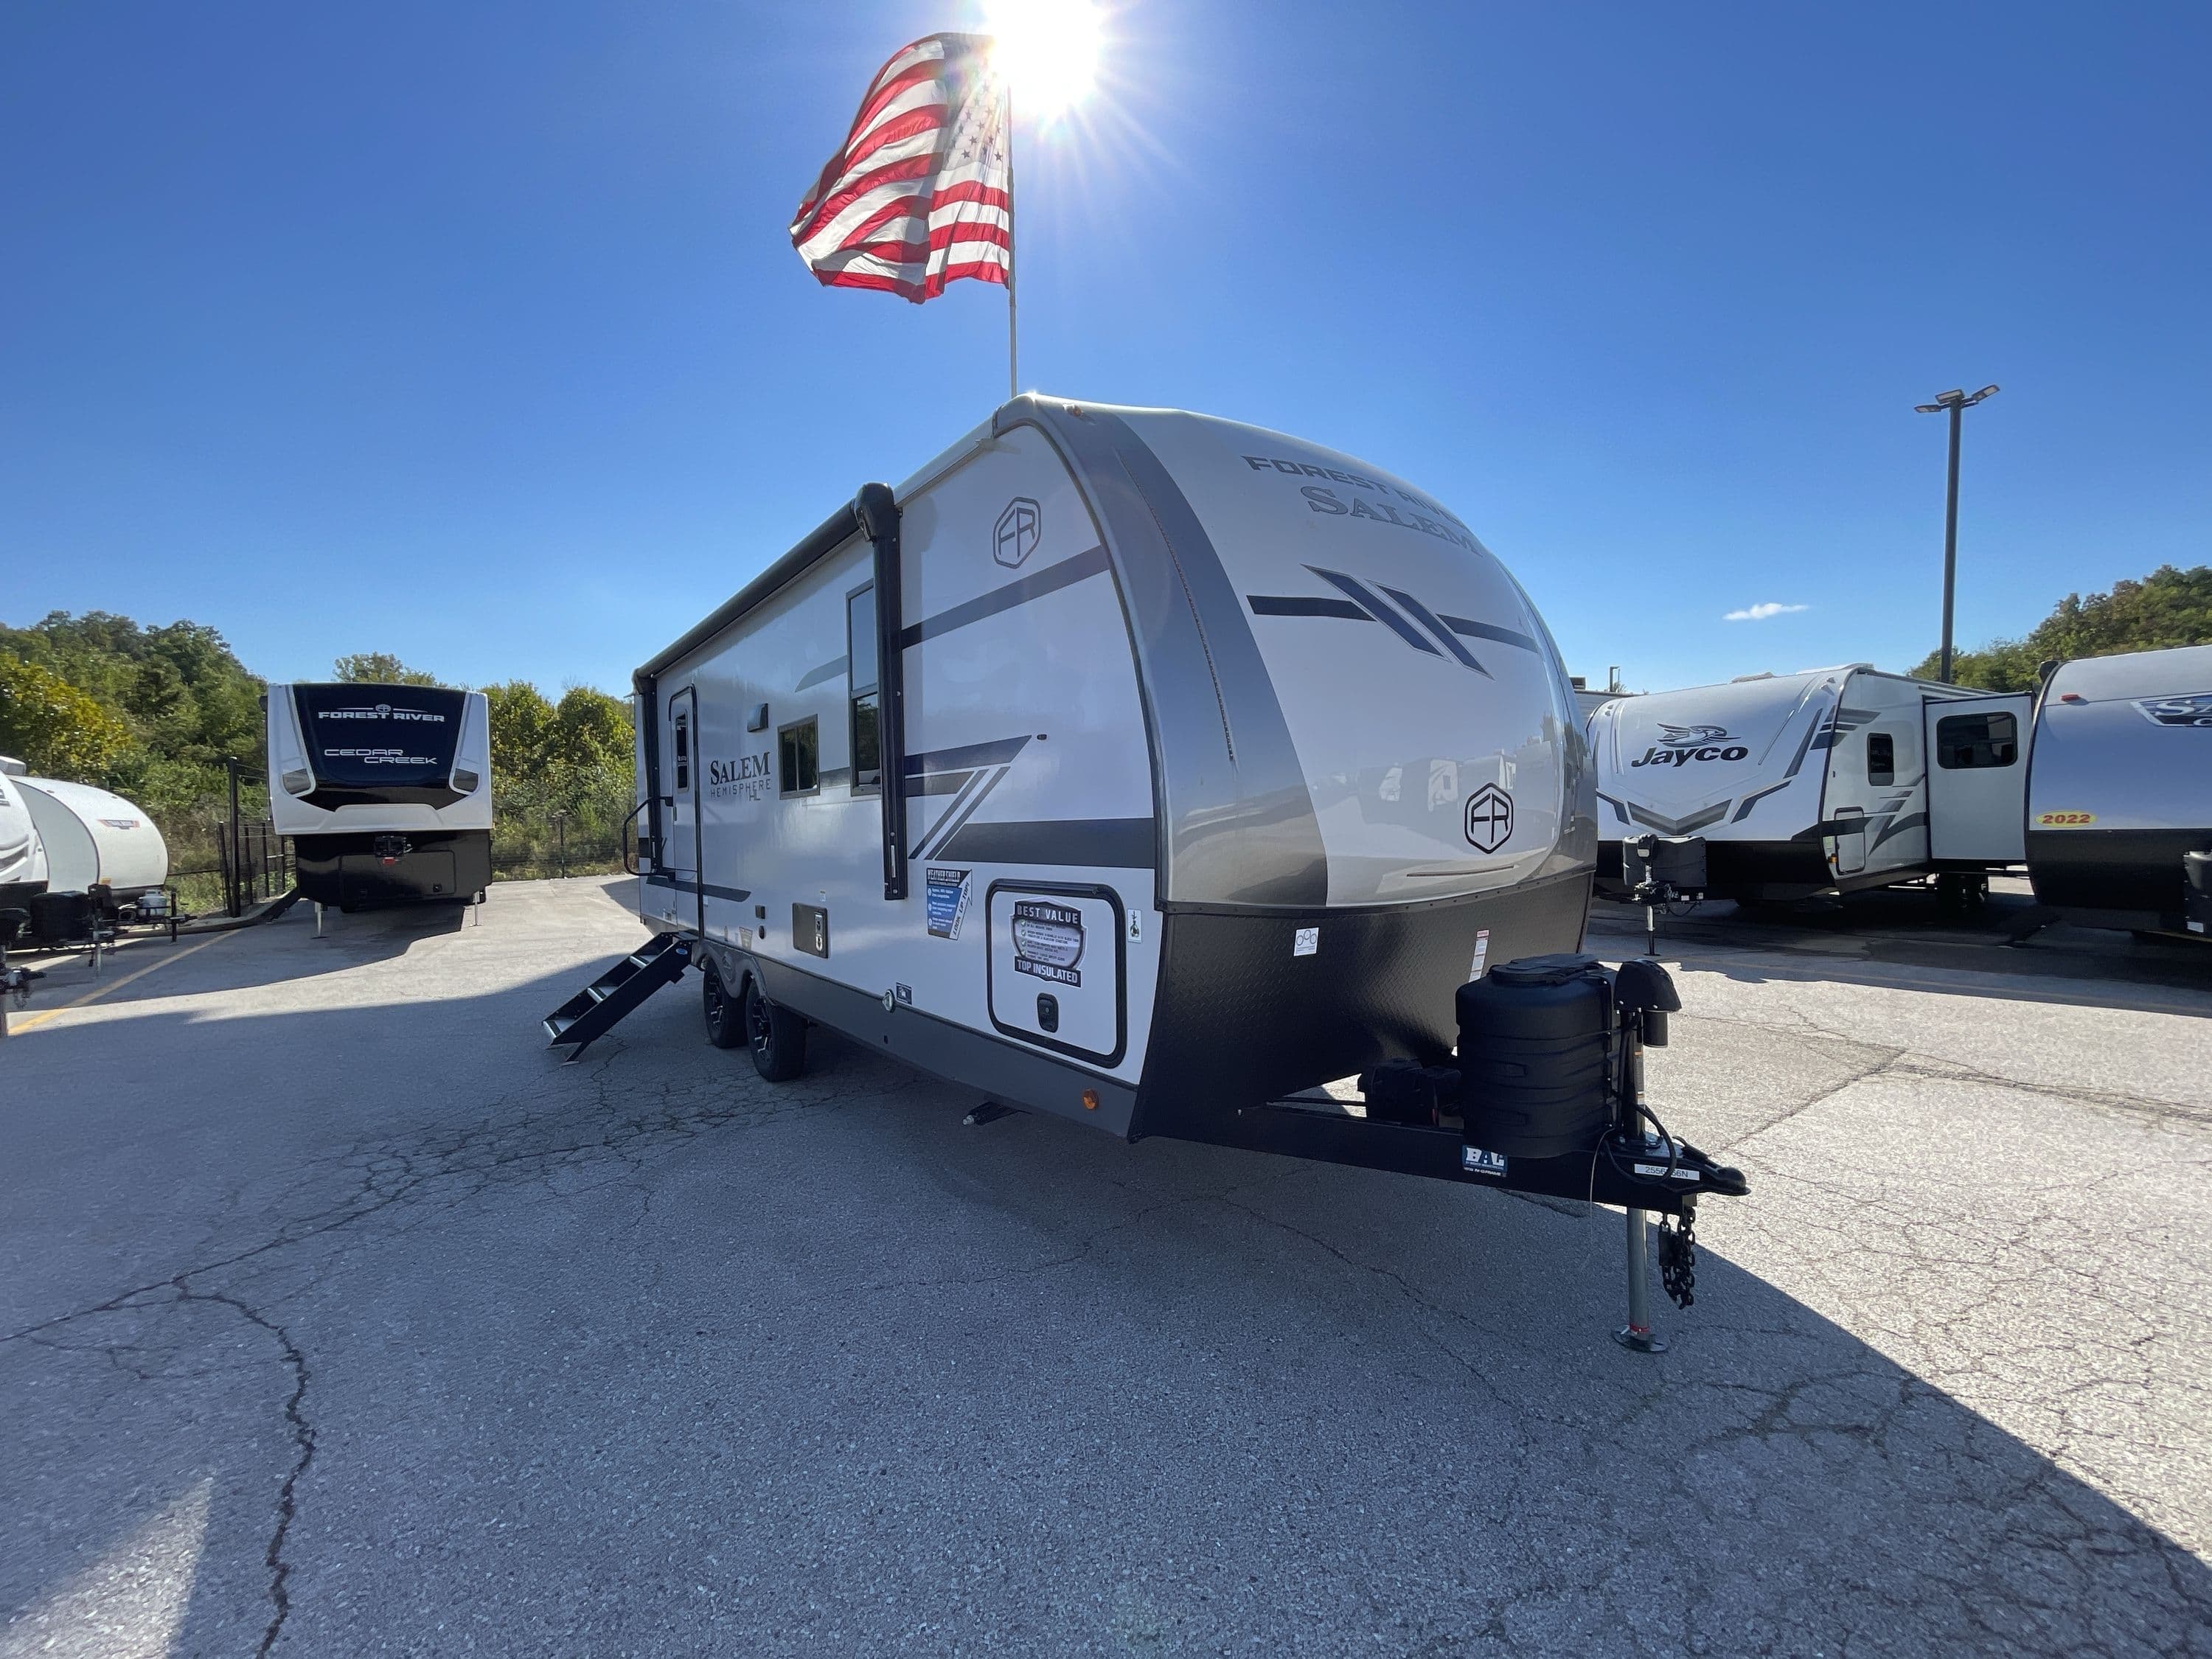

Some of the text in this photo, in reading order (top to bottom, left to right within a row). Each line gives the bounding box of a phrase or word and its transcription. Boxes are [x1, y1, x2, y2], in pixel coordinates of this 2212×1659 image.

[1241, 455, 1389, 495] FOREST
[1300, 485, 1484, 557] SALEM
[393, 712, 445, 722] RIVER
[364, 757, 438, 765] CREEK
[1631, 745, 1748, 768] Jayco
[710, 751, 771, 786] SALEM
[710, 778, 772, 798] HEMISPHERE
[2042, 814, 2090, 824] 2022
[1017, 905, 1079, 924] BEST VALUE
[1017, 959, 1078, 984] TOP INSULATED
